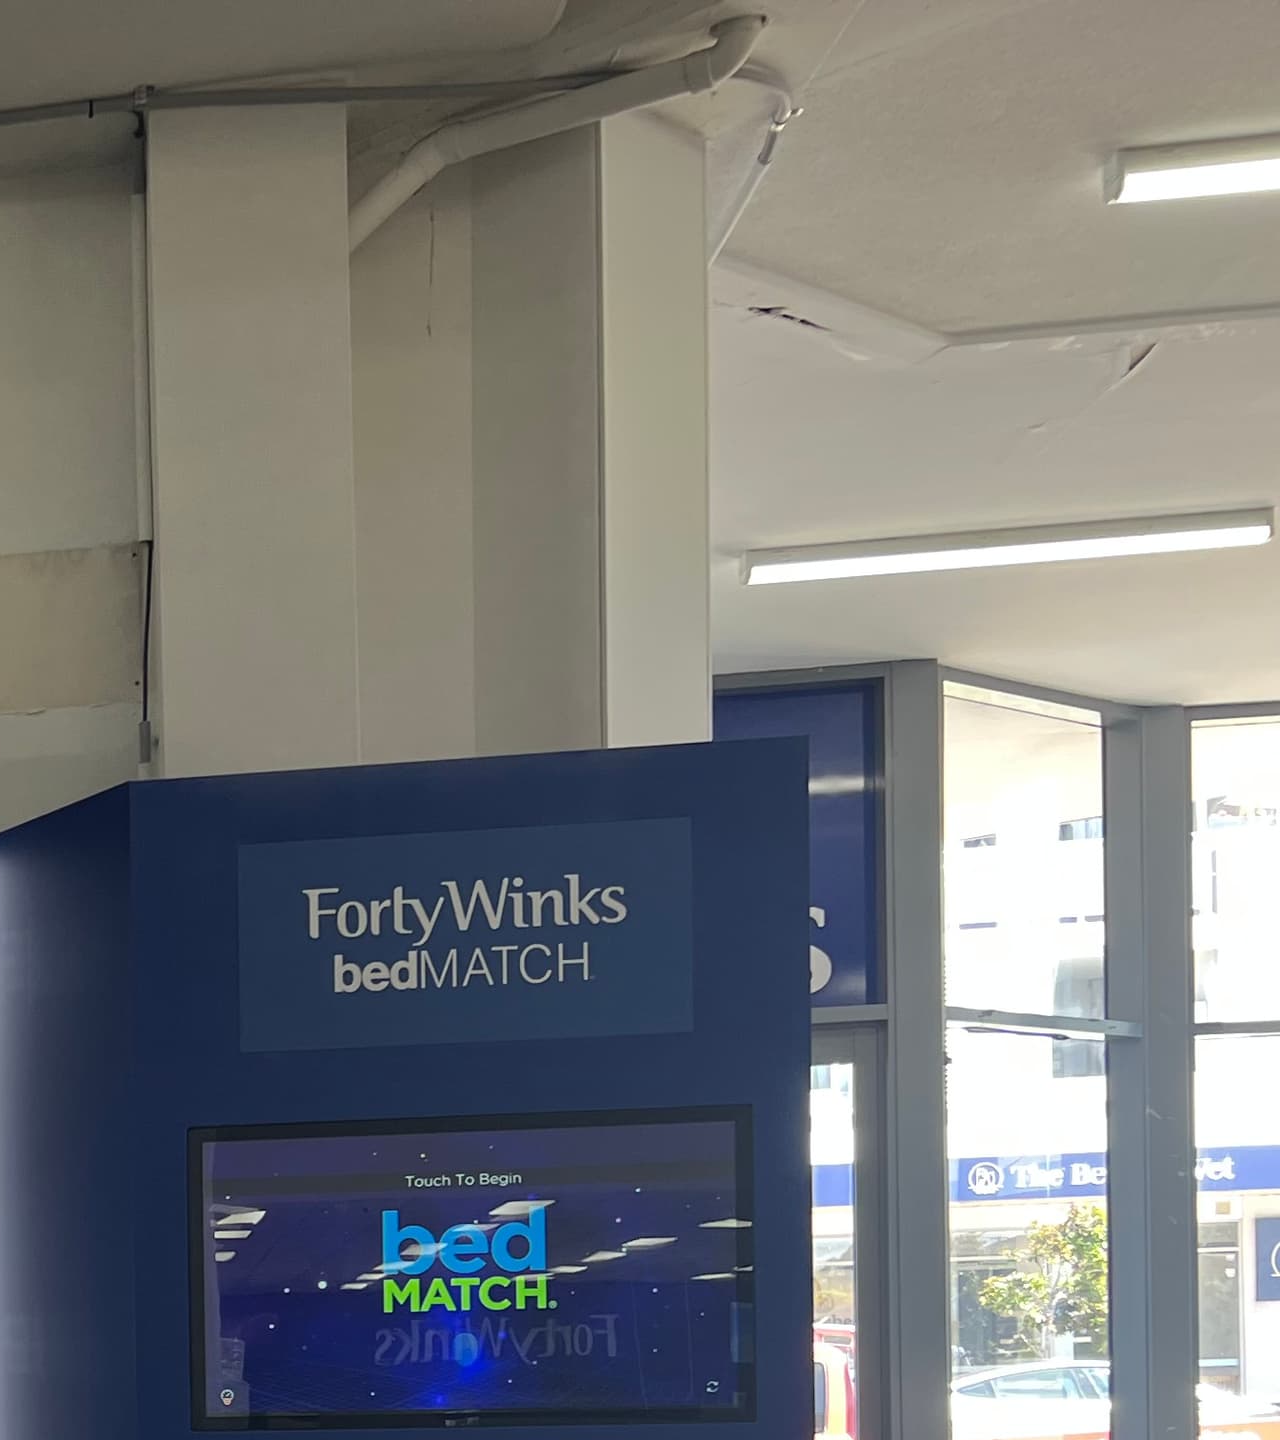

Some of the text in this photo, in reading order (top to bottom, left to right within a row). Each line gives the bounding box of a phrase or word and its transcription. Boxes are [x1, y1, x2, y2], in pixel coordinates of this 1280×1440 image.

[333, 941, 589, 993] bedMATCH
[405, 1172, 522, 1188] Touch To Begin
[382, 1205, 548, 1275] bed
